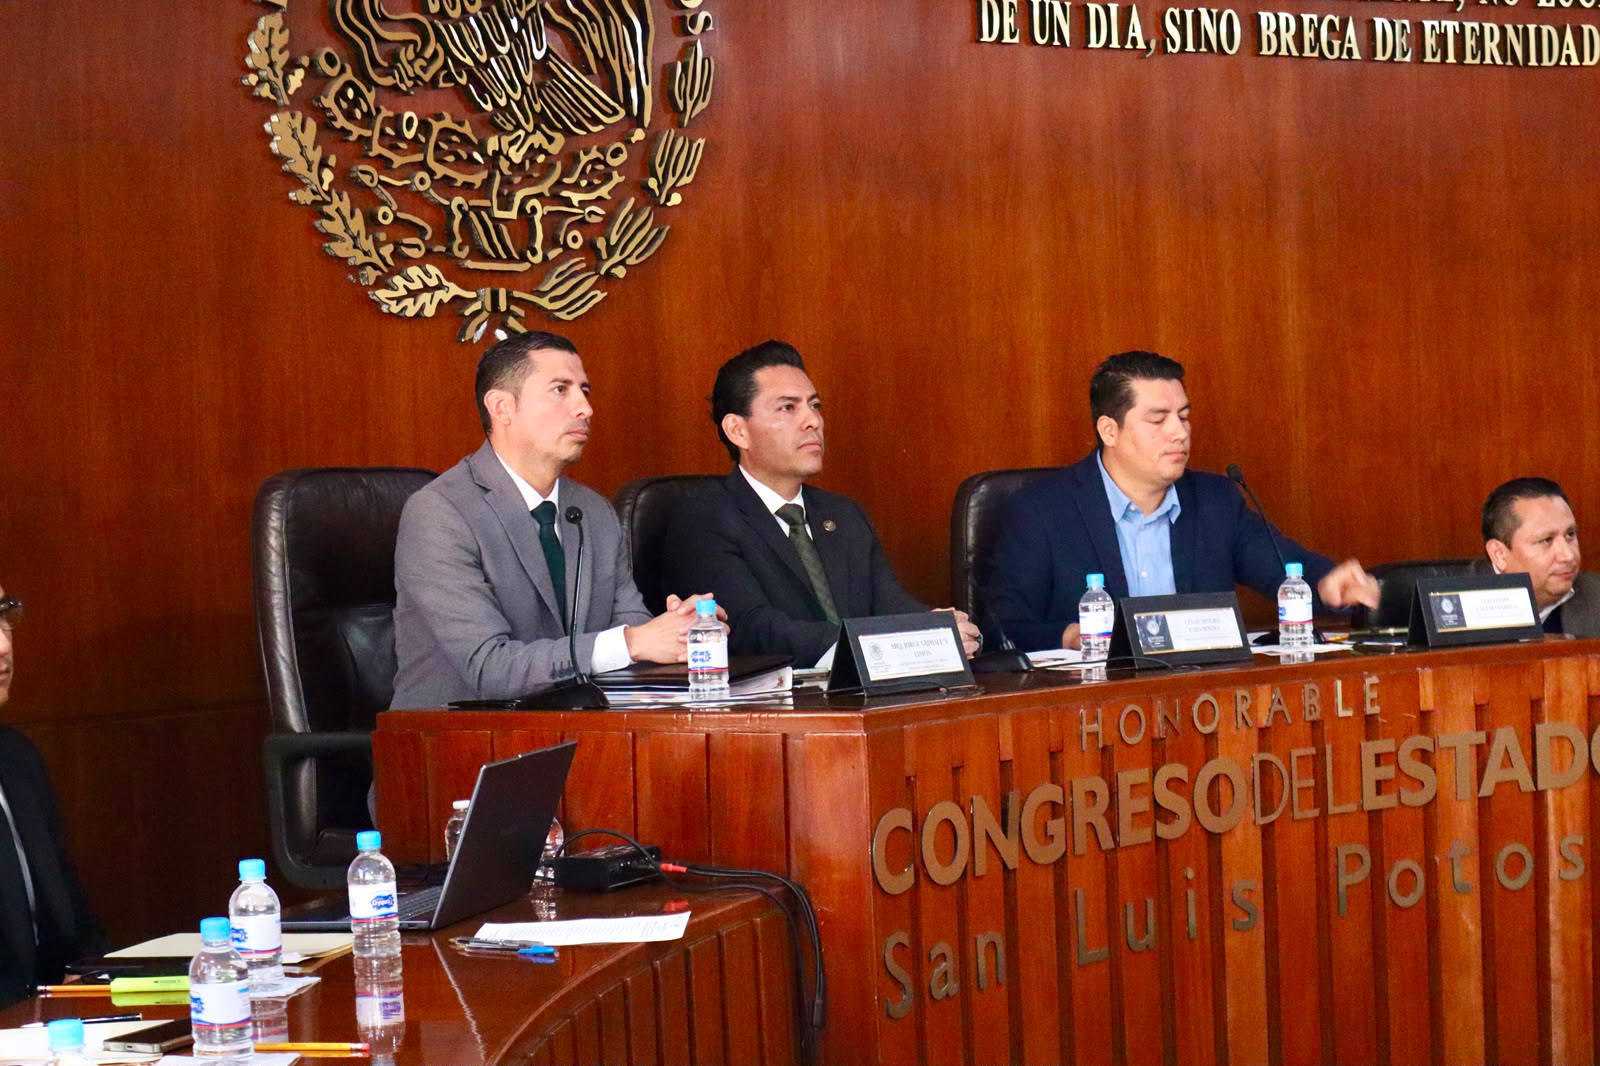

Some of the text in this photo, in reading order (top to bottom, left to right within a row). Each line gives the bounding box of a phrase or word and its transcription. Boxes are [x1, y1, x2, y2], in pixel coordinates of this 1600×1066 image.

[979, 0, 1019, 43] DE
[1031, 0, 1072, 47] UN
[1164, 8, 1241, 55] SINO
[1259, 11, 1362, 60] BREGA
[1373, 17, 1412, 62] DE
[1422, 19, 1600, 67] ETERNIDAD
[1079, 675, 1381, 751] HONORABLE
[872, 722, 1600, 895] CONGRESO DEL ESTAD
[883, 833, 1585, 1019] San Luis Potos
